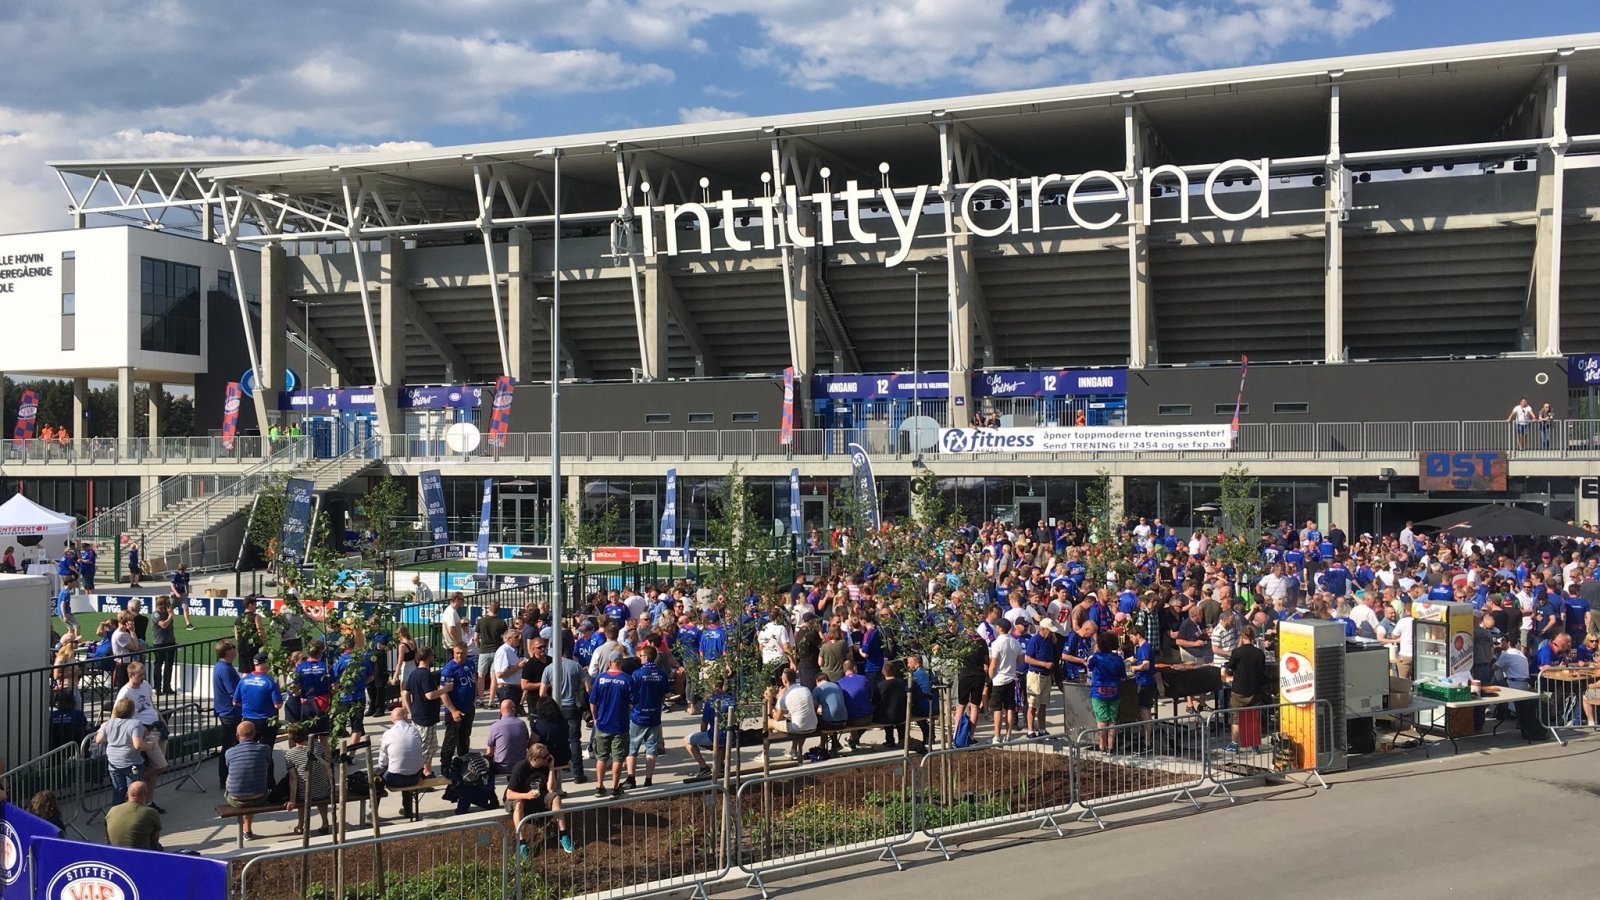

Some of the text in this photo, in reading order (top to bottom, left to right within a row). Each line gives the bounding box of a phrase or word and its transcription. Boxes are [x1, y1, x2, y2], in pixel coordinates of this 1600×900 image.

[635, 157, 1270, 268] intility arena
[15, 253, 44, 264] HOVIN
[0, 265, 53, 279] EREGÅENDE
[877, 379, 889, 394] 12
[1044, 376, 1113, 390] 12 INNGANG
[327, 393, 337, 406] 14
[970, 430, 1035, 452] fitness
[1043, 430, 1226, 441] åpner toppmoderne treningssenter!
[1043, 442, 1067, 450] Send
[1070, 442, 1116, 450] TRENING
[1119, 441, 1130, 449] til
[1133, 441, 1159, 449] 2454
[1161, 443, 1174, 451] og
[1426, 451, 1501, 477] ØST
[1334, 478, 1348, 497] F
[1582, 479, 1598, 498] E
[101, 604, 122, 613] BYGG
[217, 607, 239, 616] BYGG
[66, 867, 115, 882] STIFTET
